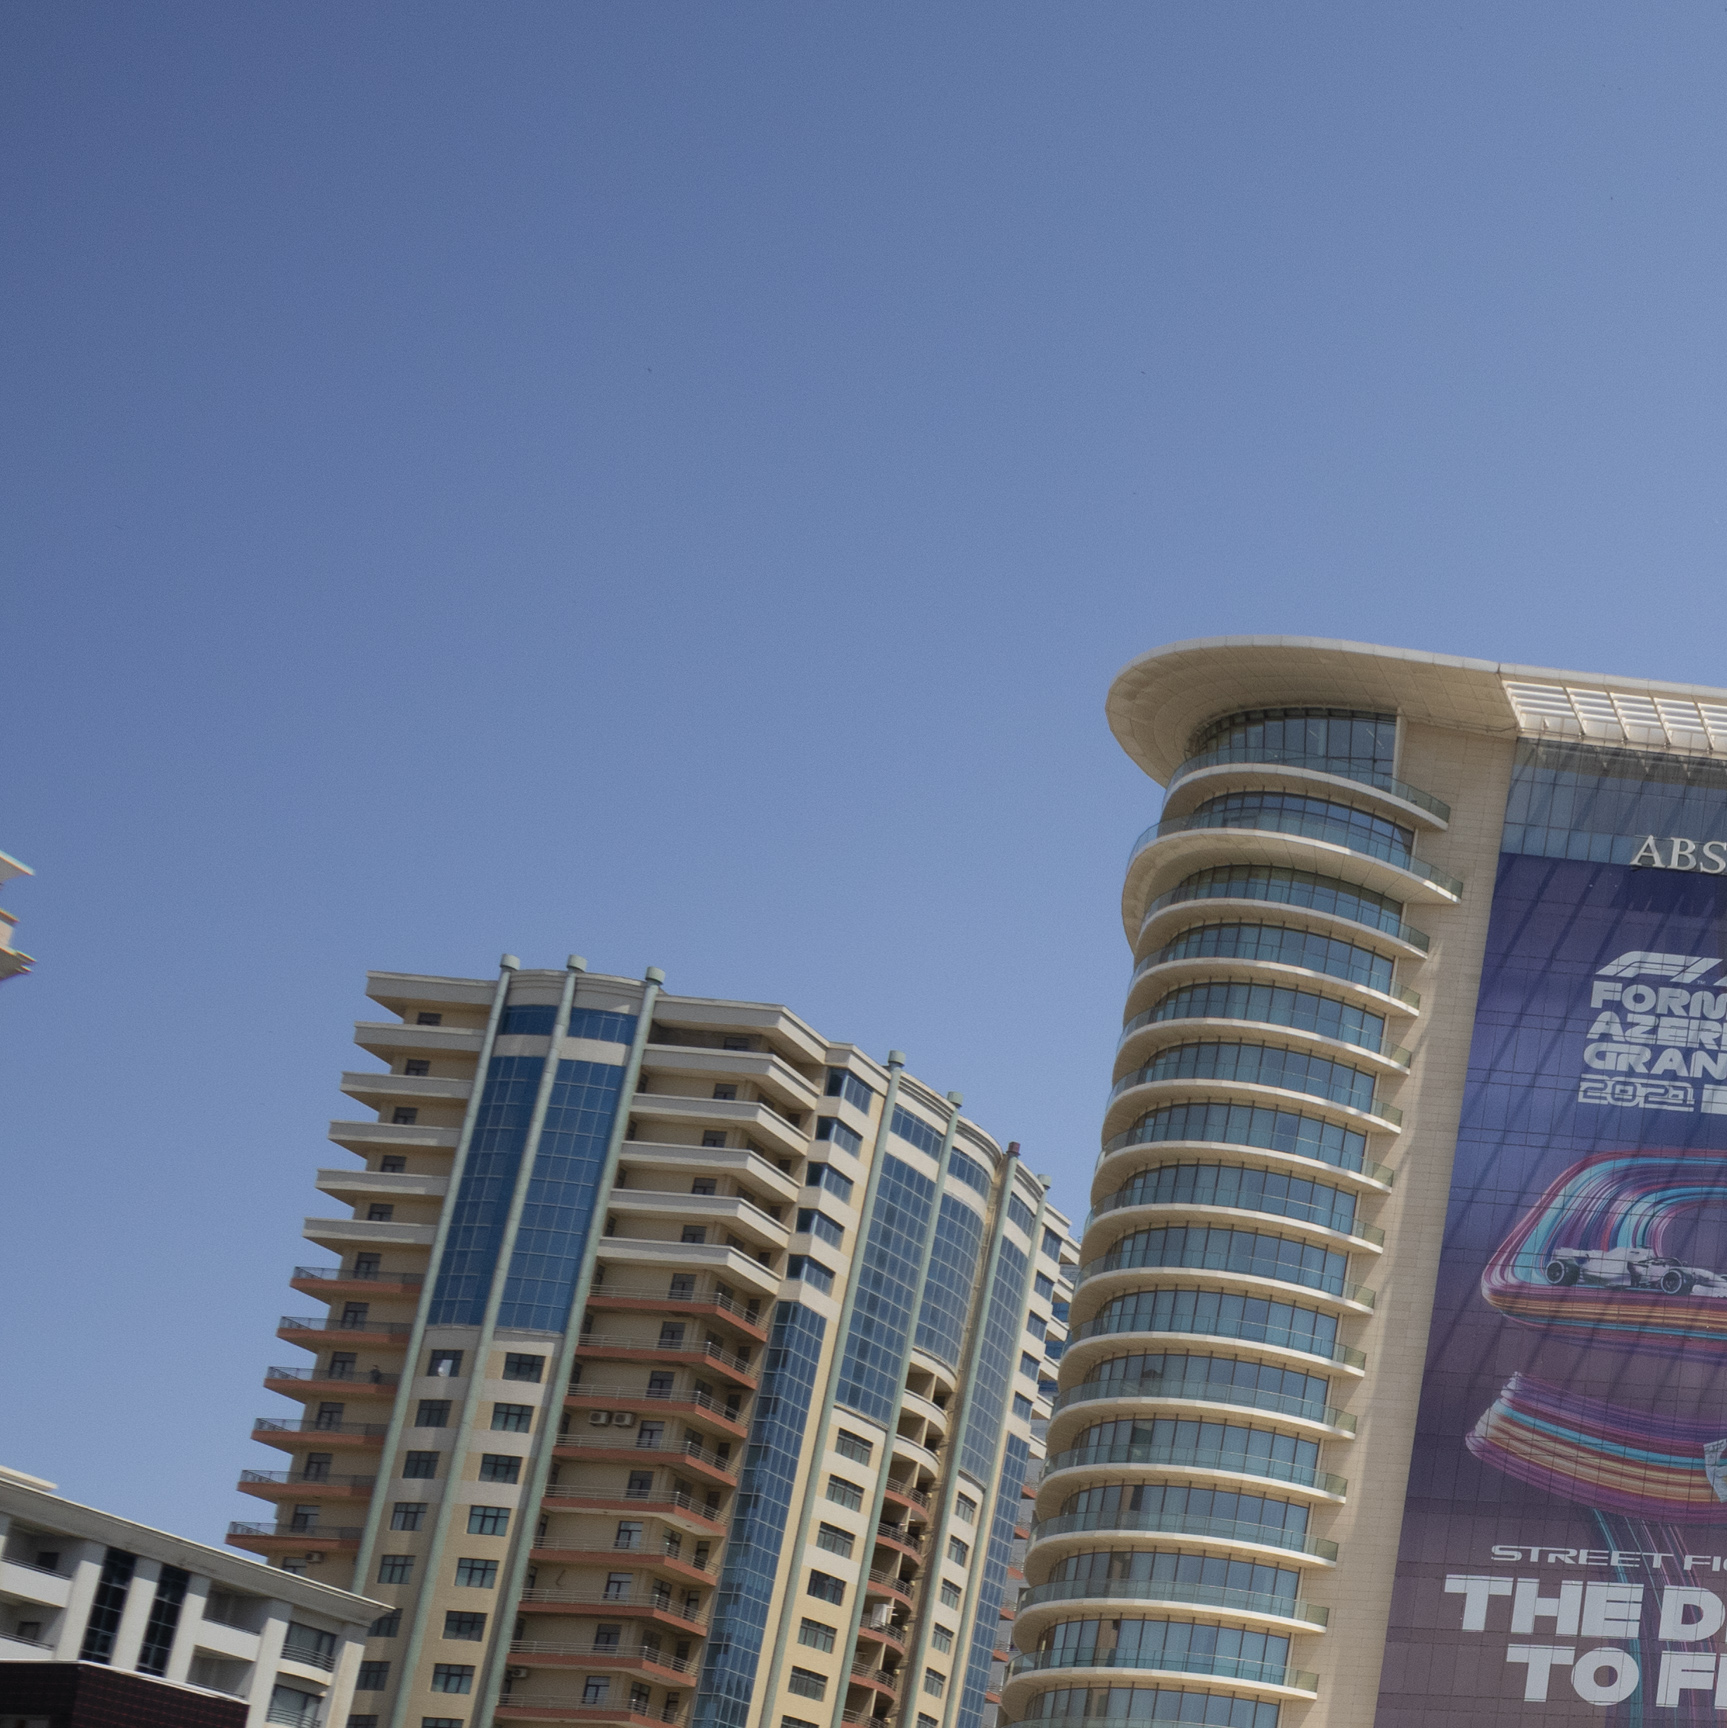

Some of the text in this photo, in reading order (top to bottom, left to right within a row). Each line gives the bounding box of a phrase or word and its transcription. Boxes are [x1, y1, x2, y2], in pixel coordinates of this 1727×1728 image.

[1577, 1074, 1695, 1113] 2021
[1491, 1544, 1674, 1569] STREET
[1443, 1574, 1645, 1639] THE
[1506, 1644, 1640, 1706] TO
